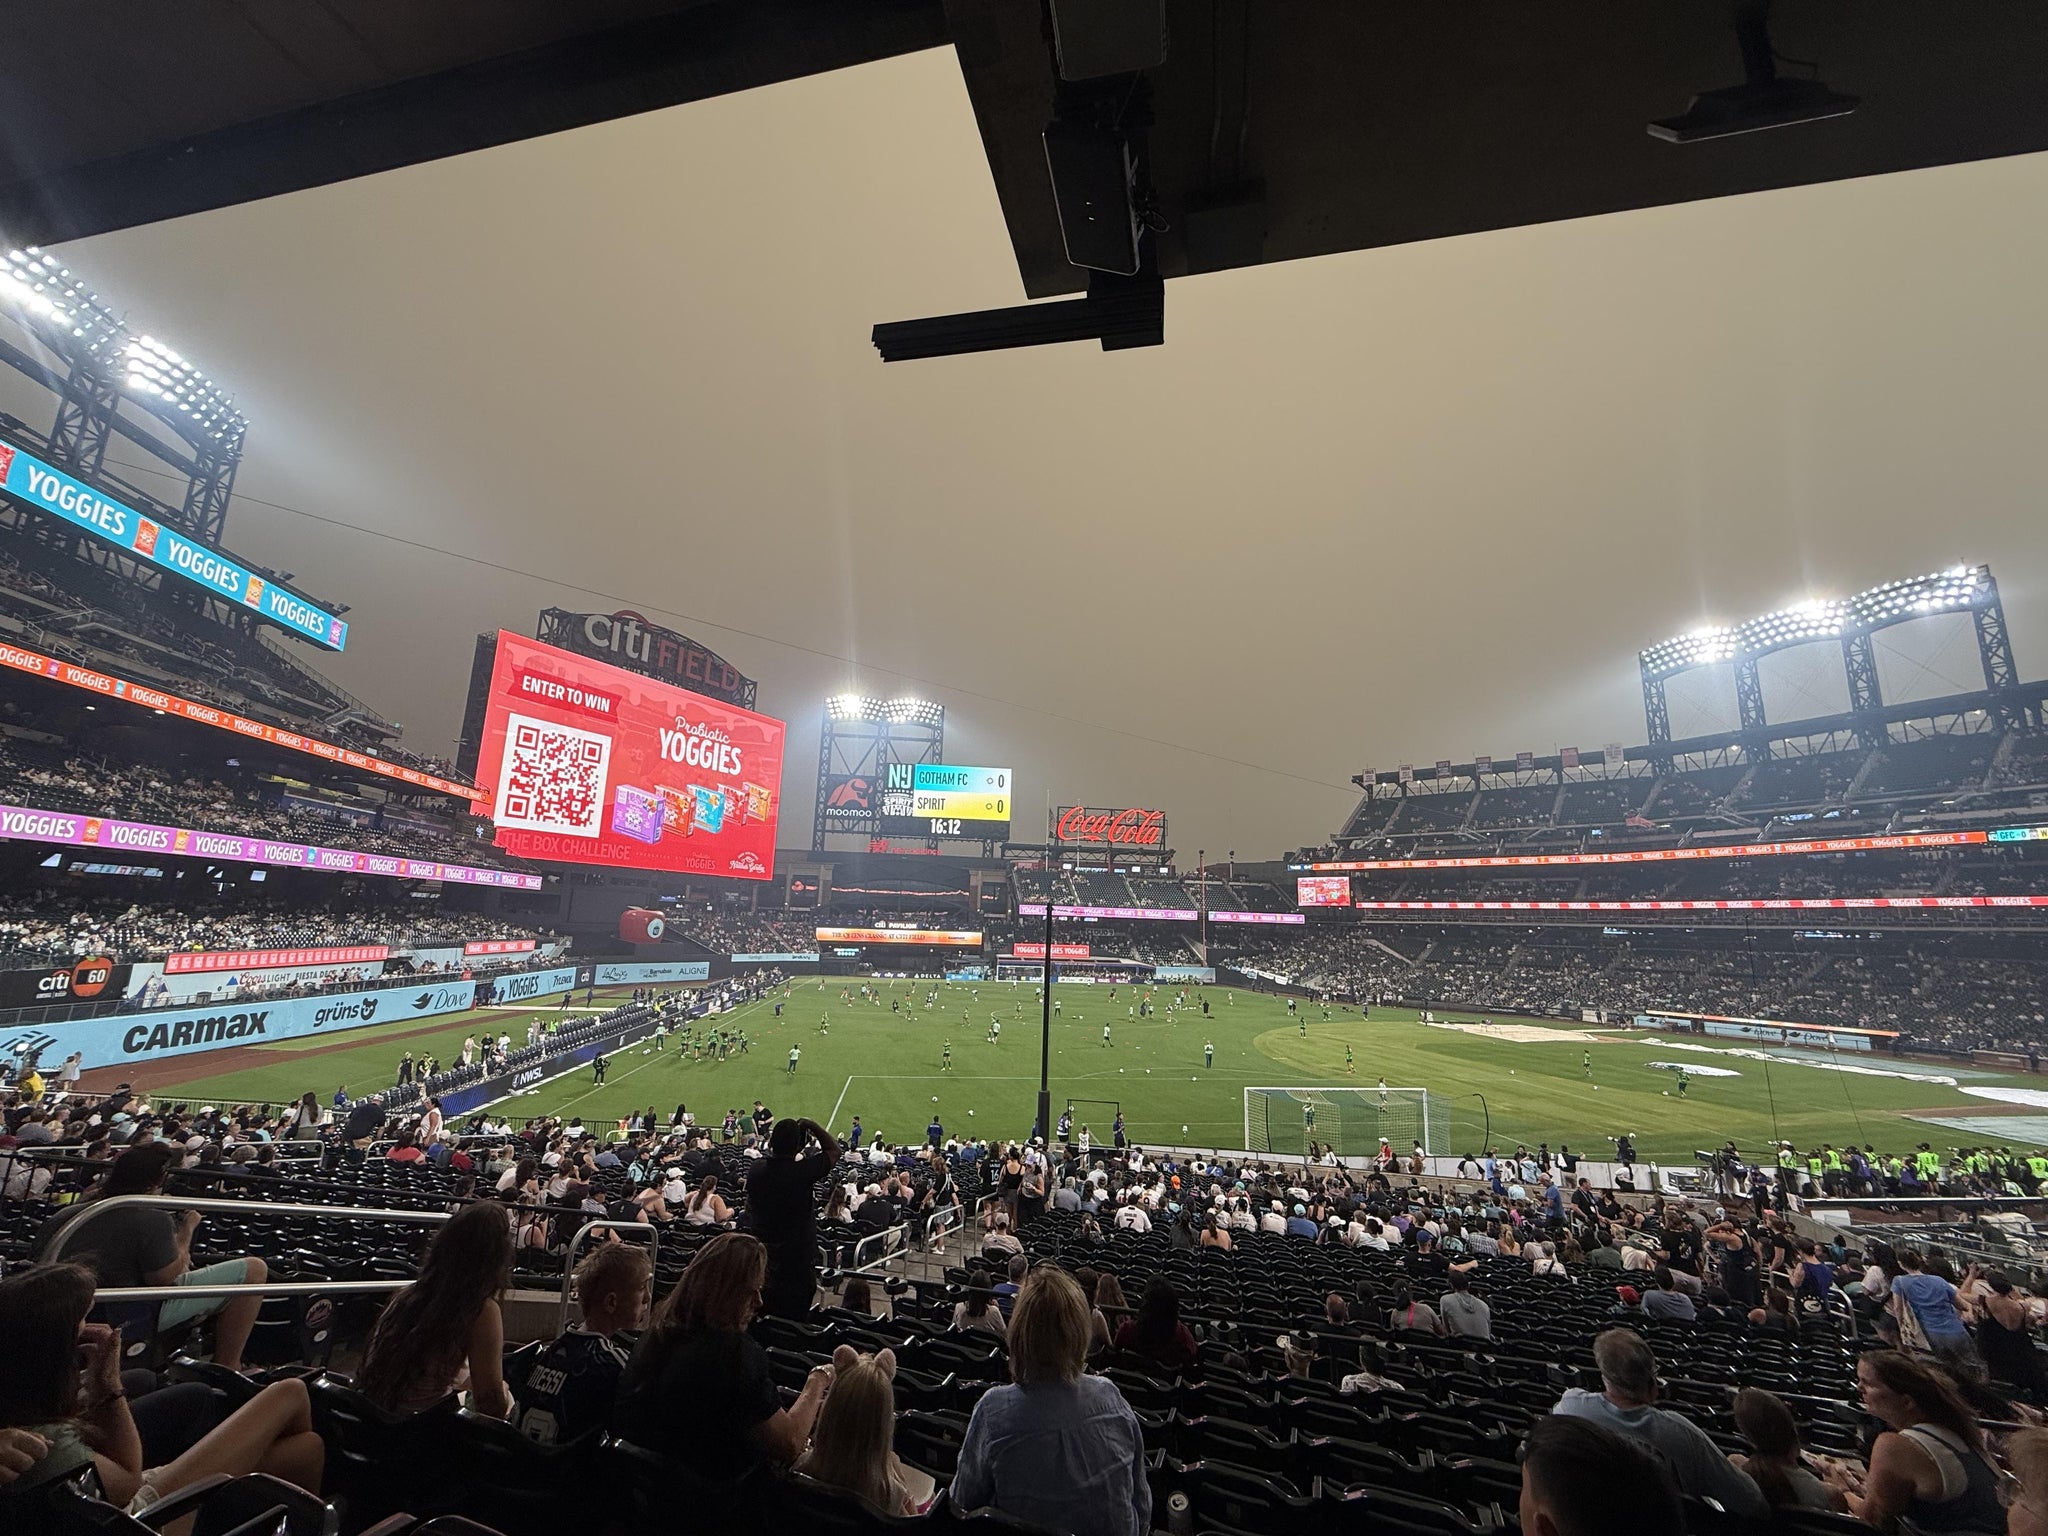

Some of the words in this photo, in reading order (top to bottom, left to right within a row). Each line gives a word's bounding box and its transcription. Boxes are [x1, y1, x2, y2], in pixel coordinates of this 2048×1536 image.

[28, 464, 127, 536] YOGGIES
[168, 538, 240, 592] YOGGIES
[270, 591, 325, 635] YOGGIES
[584, 614, 651, 663] citi
[657, 638, 740, 692] FIELD
[522, 675, 565, 700] ENTER
[566, 687, 582, 705] TO
[584, 692, 610, 713] WIN
[66, 667, 110, 692] YOGGIES
[131, 687, 169, 708] YOGGIES
[186, 704, 219, 723] YOGGIES
[233, 718, 263, 736] YOGGIES
[276, 732, 302, 747] YOGGIES
[312, 743, 336, 757] YOGGIES
[674, 715, 730, 744] Probiotic
[659, 728, 742, 776] YOGGIES
[920, 771, 954, 785] GOTHAM
[957, 773, 968, 786] FC
[998, 774, 1004, 788] 0
[826, 808, 872, 818] moomoo
[917, 797, 946, 810] SPIRIT
[997, 800, 1004, 814] 0
[930, 818, 961, 835] 16:12
[1057, 806, 1165, 844] Coca-Cola
[1872, 838, 1904, 846] YOGGIES
[2000, 832, 2015, 840] GFC
[0, 812, 76, 838] YOGGIES
[110, 825, 170, 848] YOGGIES
[195, 836, 243, 857] YOGGIES
[264, 844, 303, 862] YOGGIES
[320, 852, 354, 868] YOGGIES
[368, 858, 398, 873] YOGGIES
[409, 862, 434, 877] YOGGIES
[444, 868, 466, 880] YOGGIES
[474, 871, 494, 883] YOGGIES
[503, 832, 529, 850] THE
[532, 836, 559, 853] BOX
[562, 838, 632, 861] CHALLENGE
[685, 857, 716, 870] YOGGIES
[1888, 898, 1922, 906] YOGGIES
[1936, 898, 1974, 906] YOGGIES
[1992, 897, 2032, 906] YOGGIES
[1016, 946, 1038, 954] YOGGIES
[88, 969, 106, 984] 60
[267, 973, 292, 983] LIGHT
[296, 971, 318, 980] FIESTA
[678, 967, 708, 975] ALIGNE
[38, 974, 71, 991] citi
[508, 976, 539, 999] YOGGIES
[434, 989, 468, 1010] Dove
[314, 1001, 359, 1028] grüns
[520, 1068, 543, 1085] NWSL
[991, 1170, 999, 1182] 16
[1126, 1218, 1134, 1228] 7
[527, 1364, 568, 1396] MESSI
